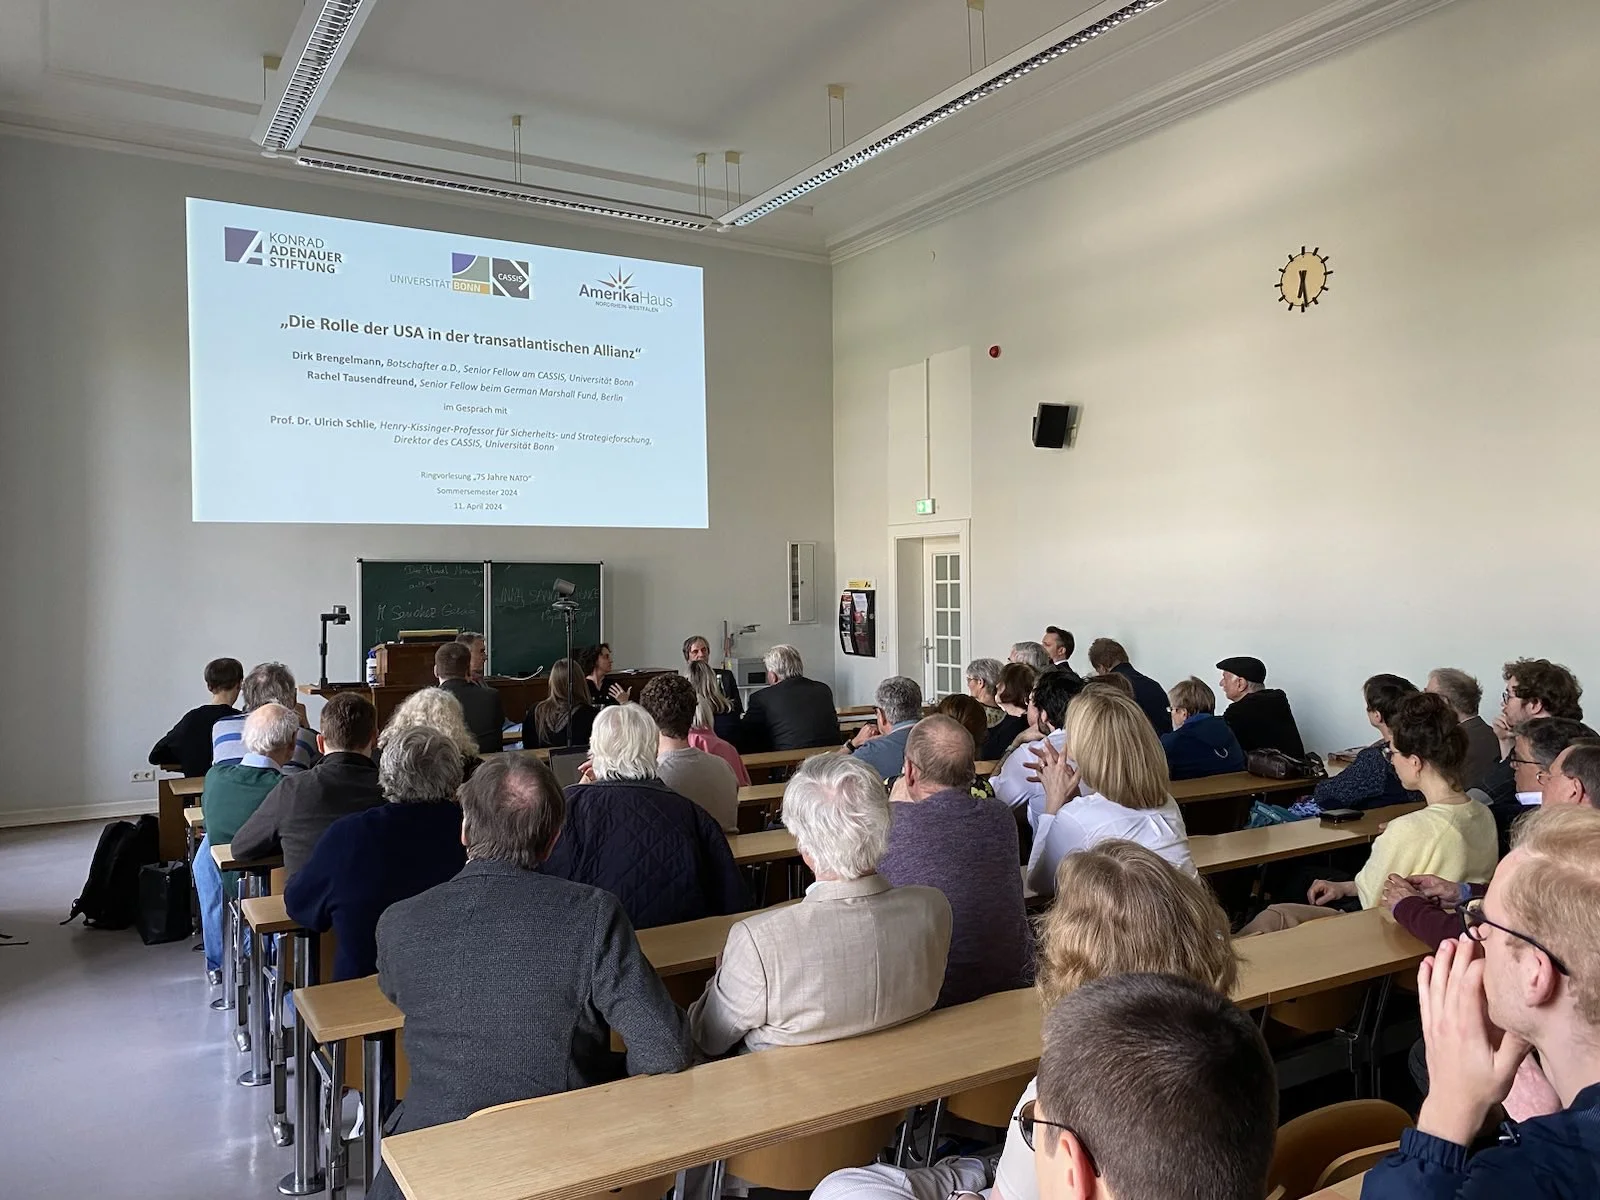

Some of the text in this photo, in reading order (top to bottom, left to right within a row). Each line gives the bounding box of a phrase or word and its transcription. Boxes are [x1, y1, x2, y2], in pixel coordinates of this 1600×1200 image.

[270, 232, 324, 249] KONRAD
[270, 245, 342, 263] ADENAUER
[270, 257, 335, 274] STIFTUNG
[498, 272, 524, 283] CASSIS
[453, 281, 481, 293] BONN
[280, 314, 641, 359] „Die Rolle der USA in der transatlantischen Allianz“
[292, 351, 313, 361] Dirk
[316, 353, 384, 368] Brengelmann,
[387, 358, 438, 371] Botschafter
[441, 363, 461, 373] a.D.,
[463, 364, 491, 375] Senior
[493, 368, 520, 377] Fellow
[537, 372, 567, 382] CASSIS,
[569, 374, 612, 385] Universität
[614, 378, 634, 386] Bonn
[307, 371, 623, 402] Rachel Tausendfreund, Senior Fellow beim German Marshall Fund, Berlin
[270, 415, 652, 446] Prof. Dr. Ulrich Schlie, Henry-Kissinger-Professor für Sicherheits- und Strategieforschung,
[394, 435, 554, 451] Direktor des CASSIS, Universität Bonn
[420, 472, 471, 481] Ringvorlesung
[487, 473, 508, 481] Jahre
[437, 487, 499, 496] Sommersemester
